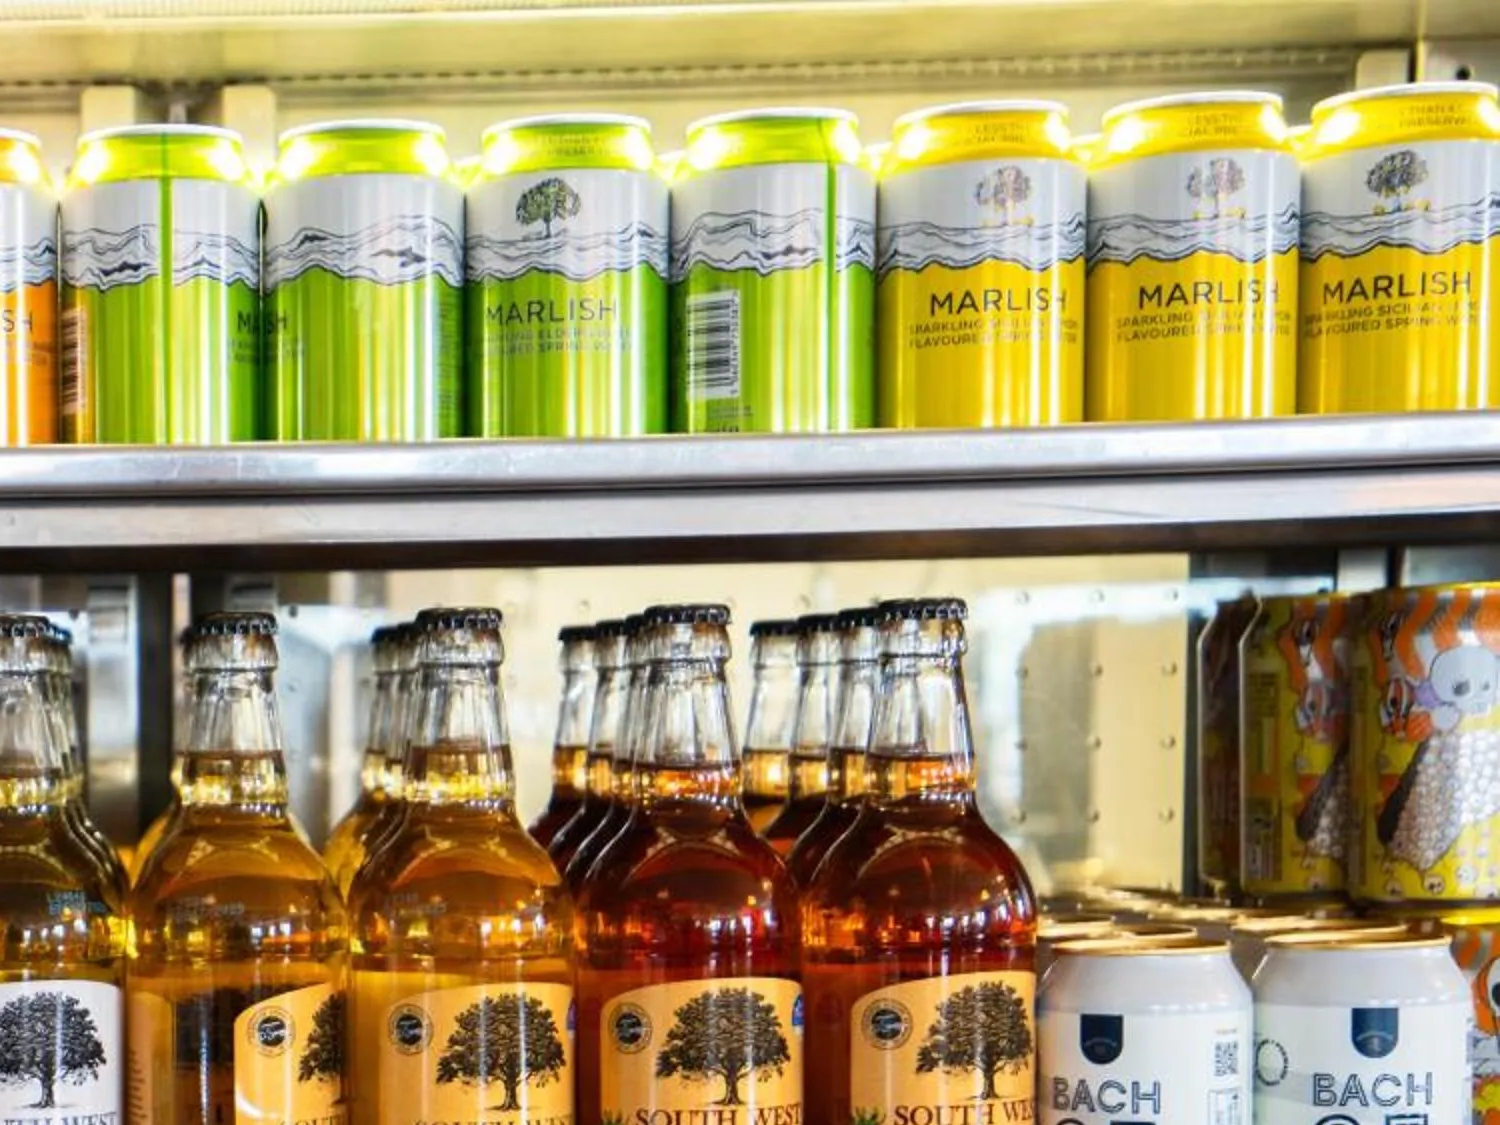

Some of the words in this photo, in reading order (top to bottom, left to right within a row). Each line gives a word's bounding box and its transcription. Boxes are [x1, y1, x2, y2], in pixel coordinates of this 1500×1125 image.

[930, 288, 1067, 316] MARLISH
[1138, 279, 1279, 310] MARLISH
[1322, 271, 1472, 305] MARLISH
[486, 297, 618, 326] MARLISH
[1052, 1076, 1162, 1115] BACH
[1311, 1071, 1434, 1107] BACH
